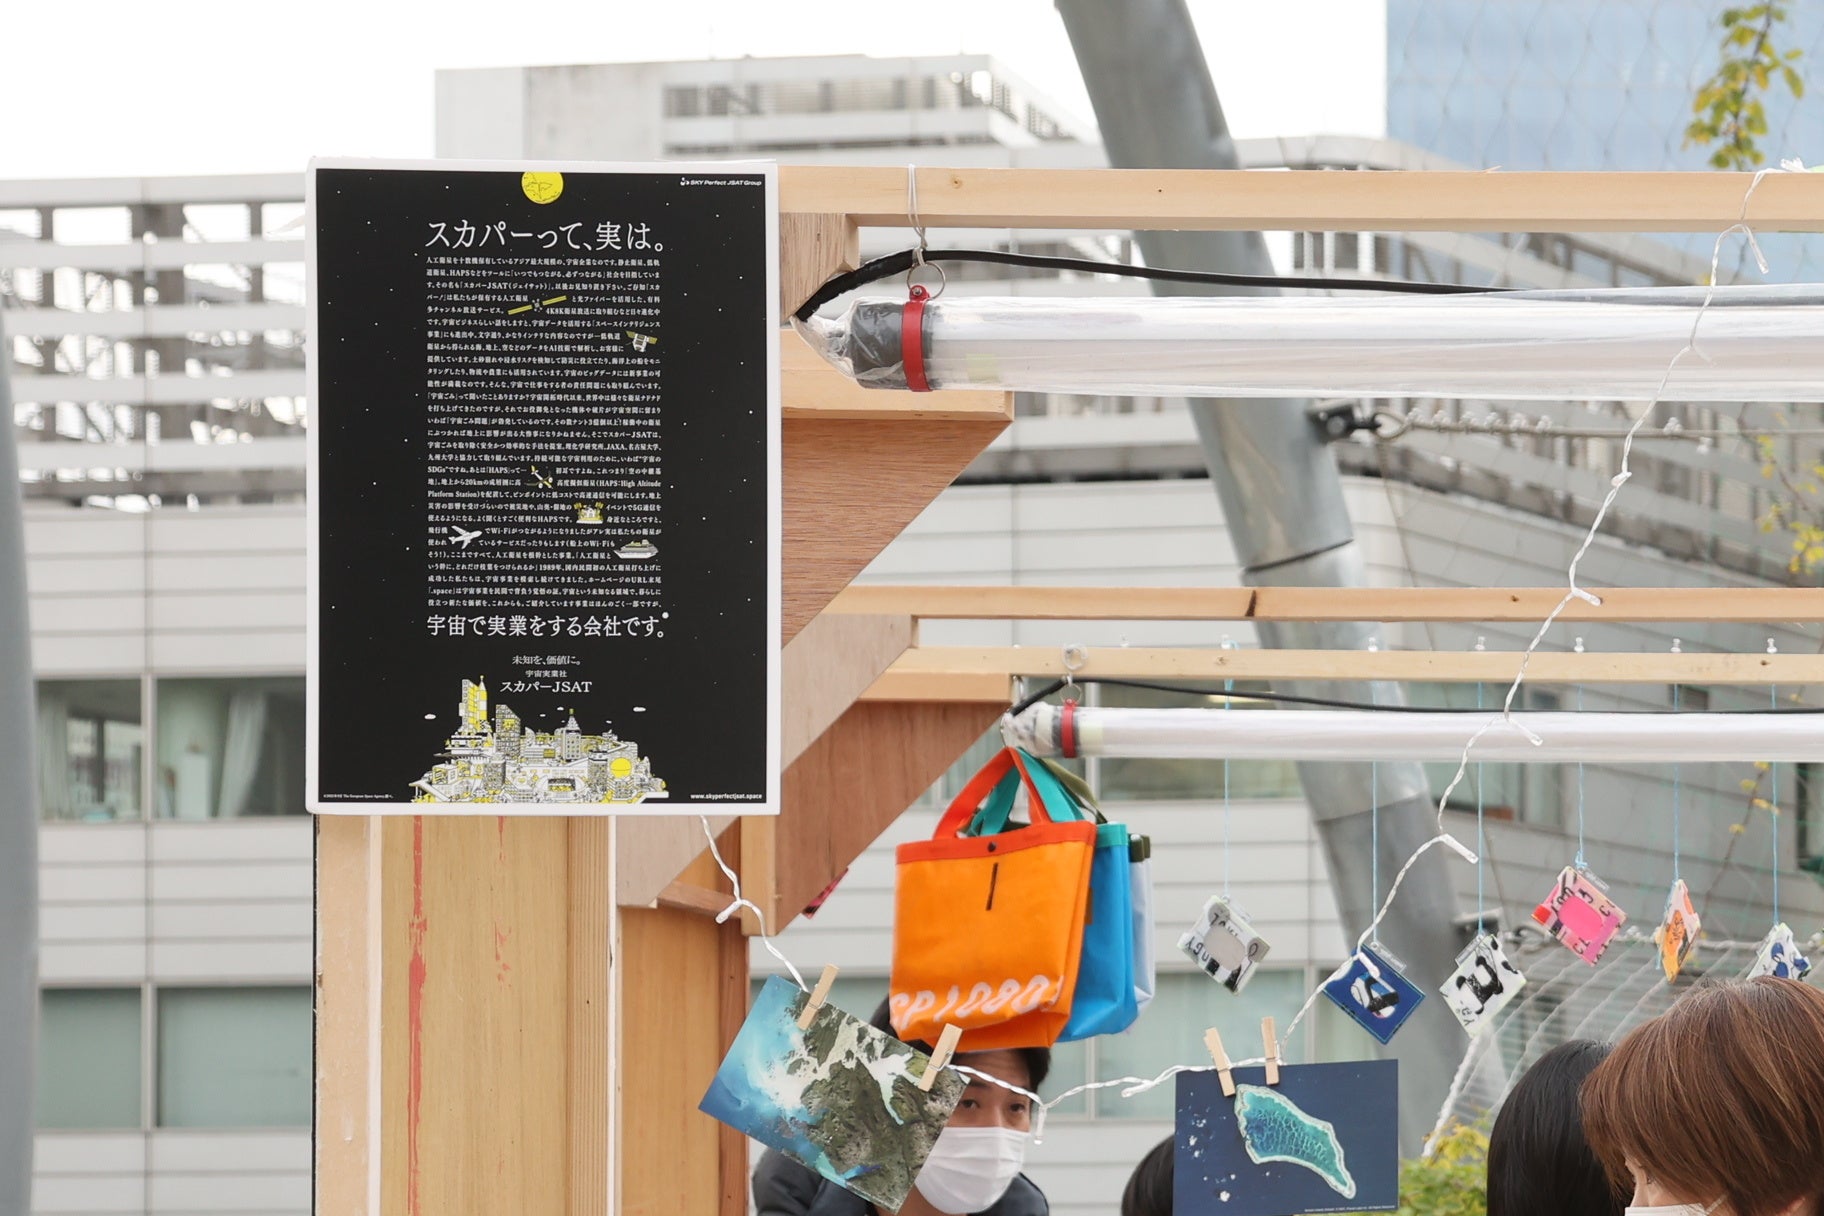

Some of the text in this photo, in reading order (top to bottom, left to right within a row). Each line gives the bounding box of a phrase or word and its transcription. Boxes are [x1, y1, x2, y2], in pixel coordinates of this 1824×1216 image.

[424, 219, 664, 253] スカパーって、実は。
[428, 489, 454, 498] Platform
[428, 538, 448, 547] 使われ
[427, 614, 665, 639] 宇宙で実業をする会社です。
[511, 654, 582, 666] 未知を、価値に。
[525, 669, 568, 678] 宇宙実業社
[499, 680, 593, 694] スカパーJSAT
